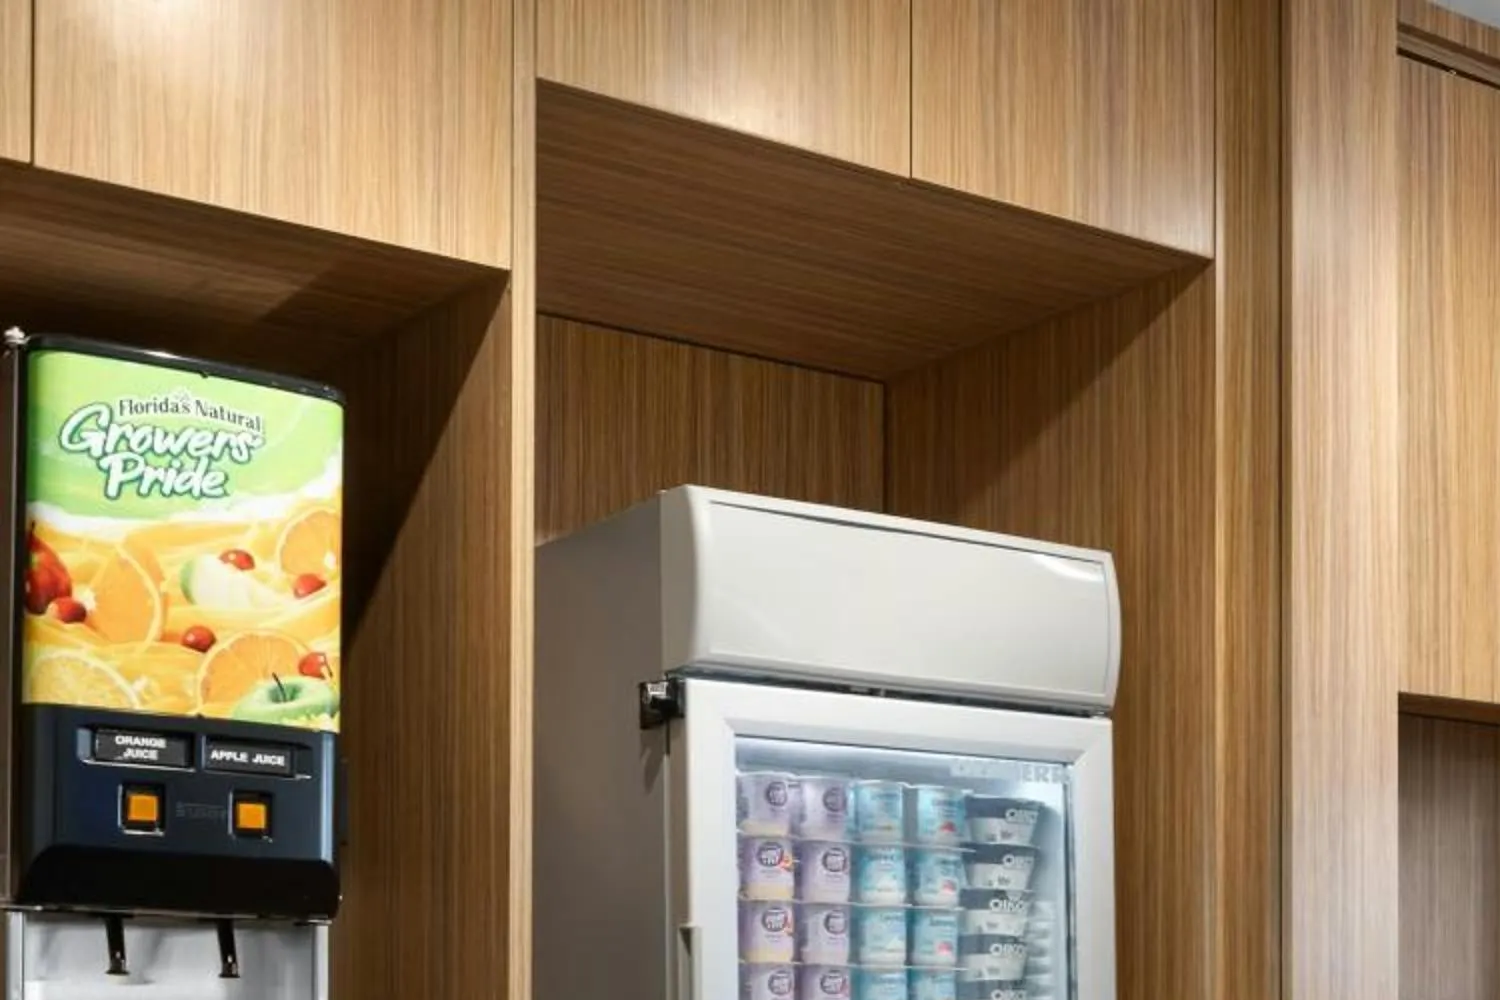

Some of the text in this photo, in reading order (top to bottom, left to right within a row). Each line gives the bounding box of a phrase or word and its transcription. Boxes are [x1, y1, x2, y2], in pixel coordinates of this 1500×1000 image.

[119, 399, 262, 431] Florida's Natural
[97, 451, 230, 500] Pride
[114, 735, 167, 748] ORANGE
[123, 748, 159, 761] JUICE
[210, 750, 286, 766] APPLE JUICE
